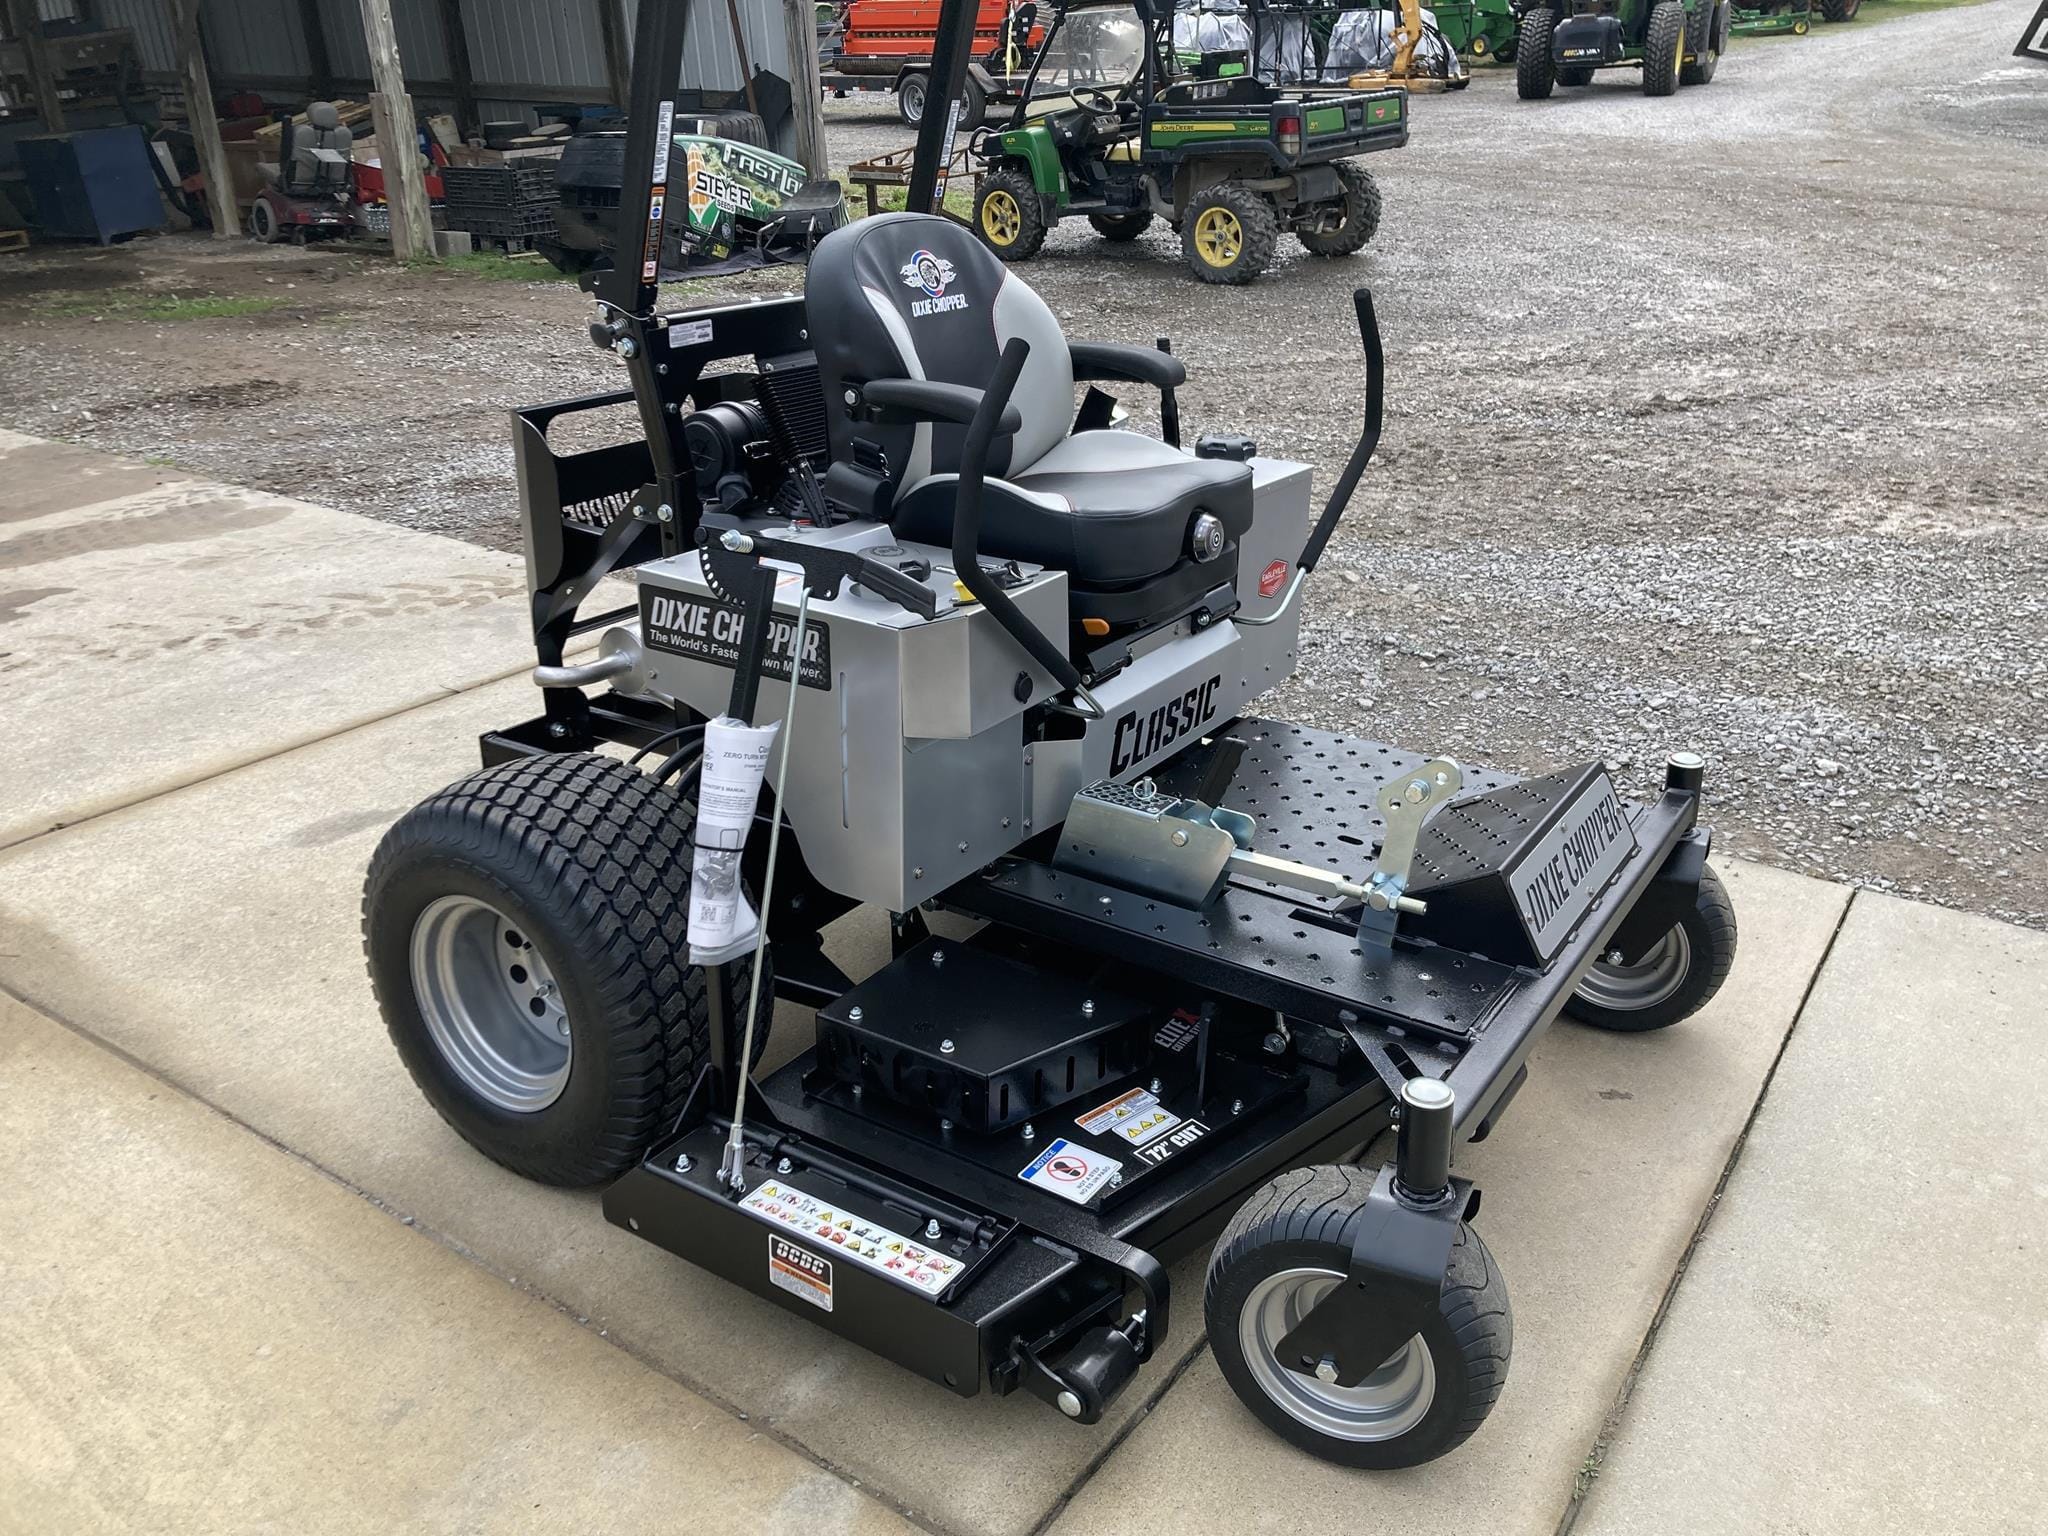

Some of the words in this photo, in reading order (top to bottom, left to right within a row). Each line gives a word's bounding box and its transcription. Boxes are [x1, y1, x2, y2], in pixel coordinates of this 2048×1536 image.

[1159, 124, 1175, 132] JOHN
[1175, 124, 1194, 132] DEERE
[694, 170, 753, 210] STEYER
[717, 200, 735, 213] SEEDS
[911, 298, 933, 318] DIXIE
[931, 293, 966, 314] CHOPPER
[650, 596, 711, 637] DIXIE
[712, 610, 821, 663] CHPER
[650, 629, 668, 643] The
[670, 632, 709, 654] World's
[711, 643, 740, 661] Faste
[1109, 673, 1221, 779] CLASSIC
[723, 751, 743, 760] ZERO
[1525, 853, 1570, 936] DIXIE
[1562, 793, 1623, 888] CHOPPER
[1171, 1008, 1200, 1025] X
[1154, 1018, 1191, 1049] ELITE
[1171, 1032, 1195, 1053] CUTTING
[1169, 1124, 1205, 1148] CUT
[1032, 1148, 1057, 1171] NOTICE
[1076, 1179, 1087, 1190] NOT
[1089, 1166, 1101, 1179] STEP
[1079, 1187, 1087, 1196] NO
[1099, 1165, 1111, 1180] PASO
[776, 1242, 825, 1275] OCDC
